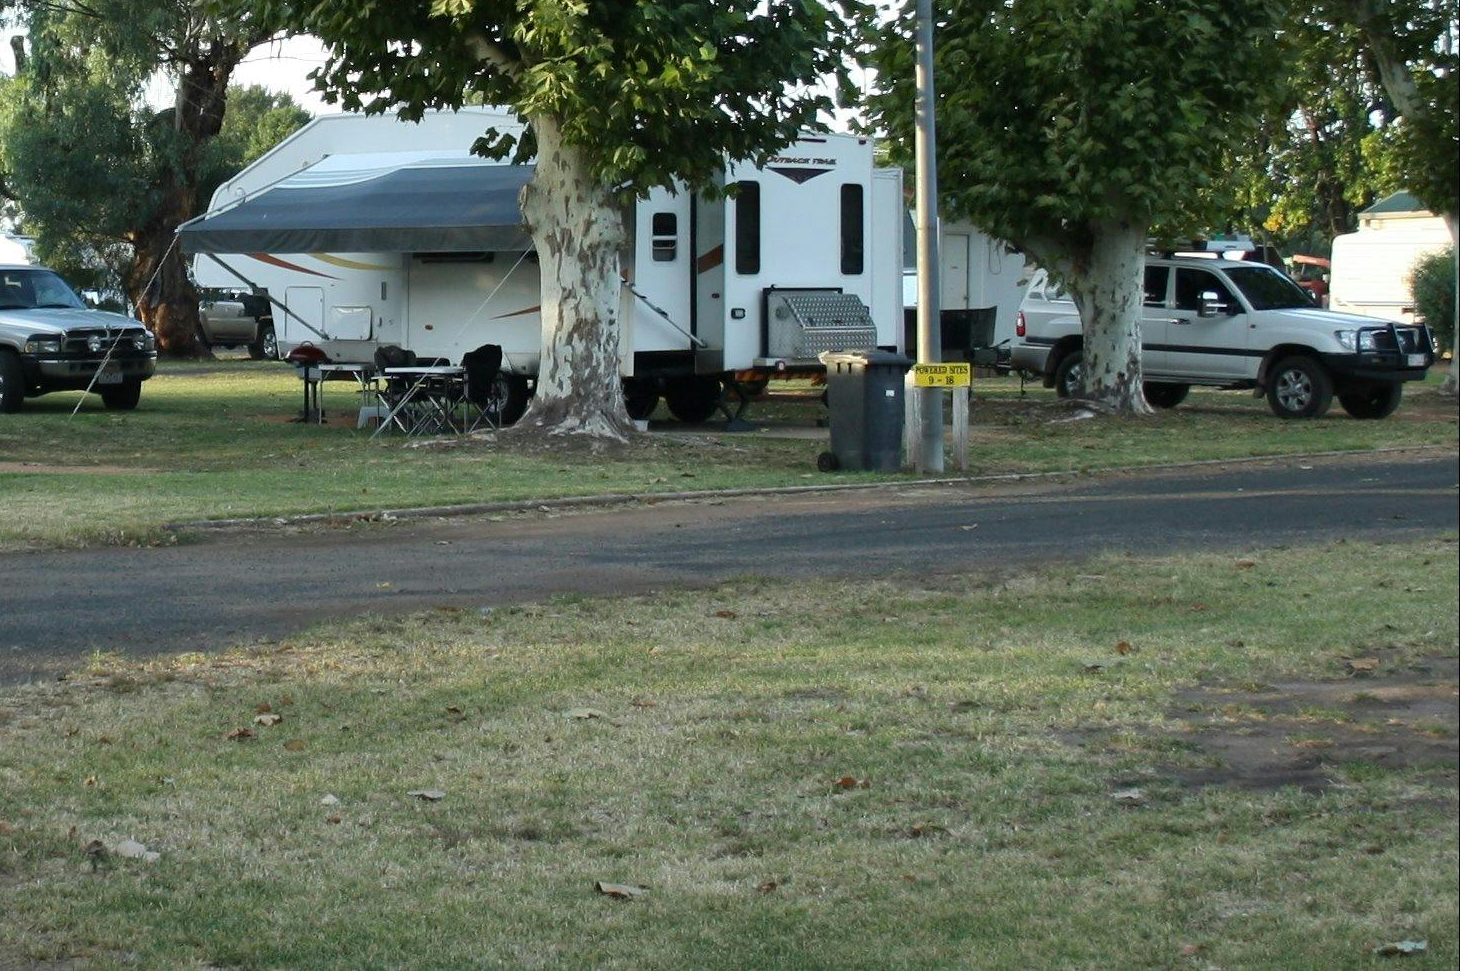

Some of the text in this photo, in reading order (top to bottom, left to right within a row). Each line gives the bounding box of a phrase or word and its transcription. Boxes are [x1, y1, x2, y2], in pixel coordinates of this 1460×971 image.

[915, 365, 968, 374] POWERED SITES
[928, 375, 935, 385] 9
